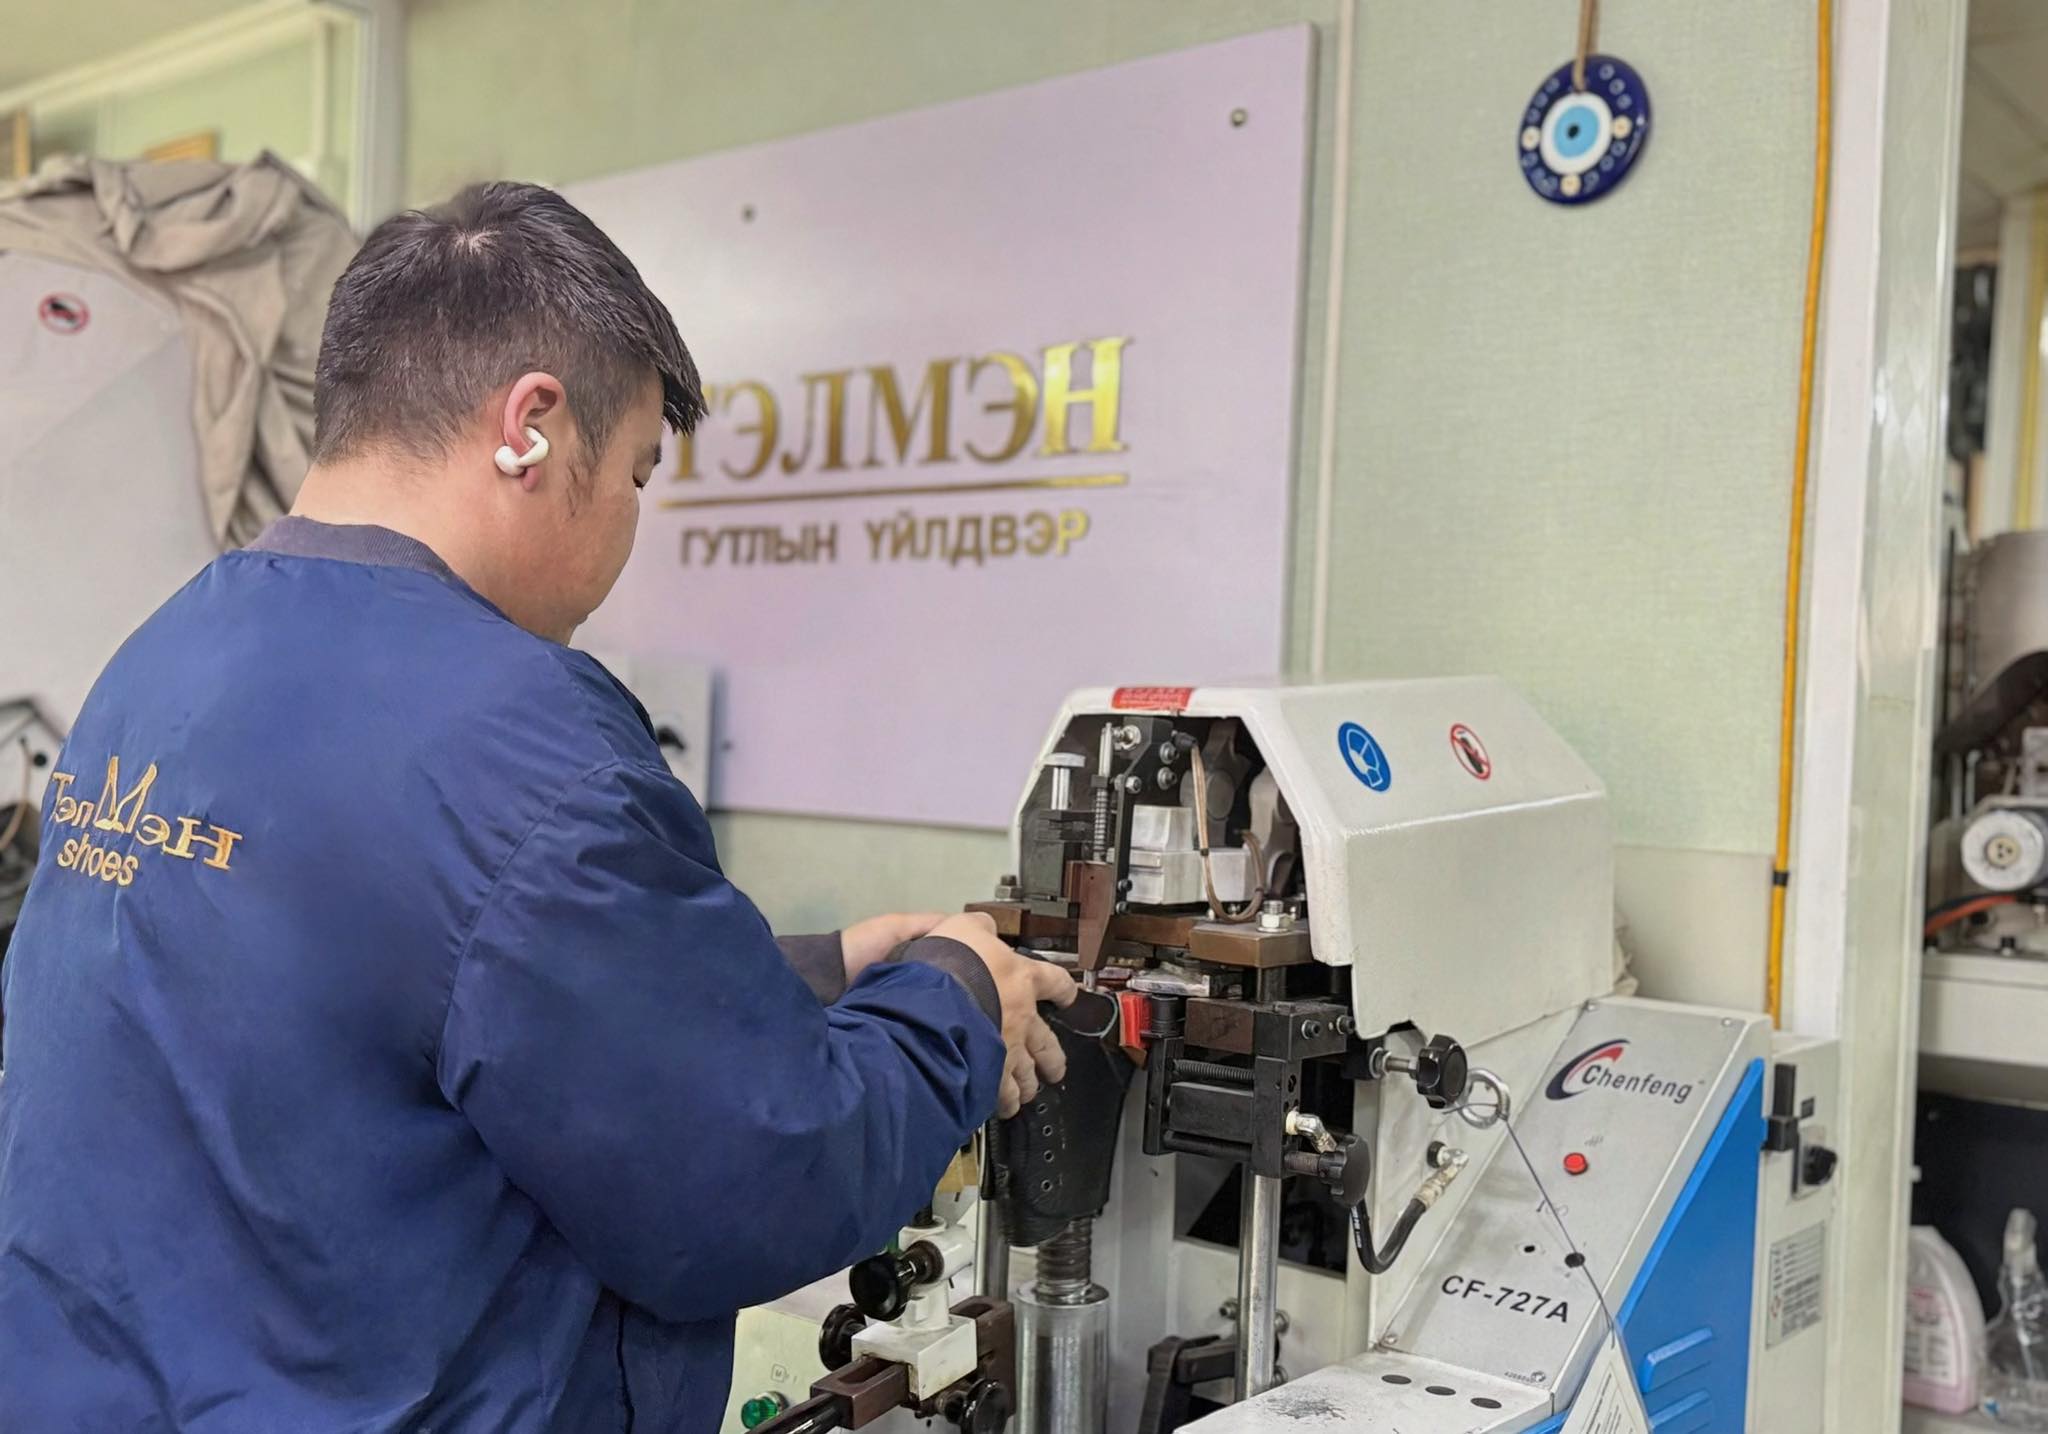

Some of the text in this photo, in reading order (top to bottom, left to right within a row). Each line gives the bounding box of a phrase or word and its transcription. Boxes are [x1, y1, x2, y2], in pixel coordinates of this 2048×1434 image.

[681, 507, 1090, 566] ГУТЛЫН ҮЙЛДВЭР
[57, 833, 139, 886] shoes
[1581, 1064, 1693, 1104] Chenfeng
[1441, 1274, 1568, 1323] CF-727A
